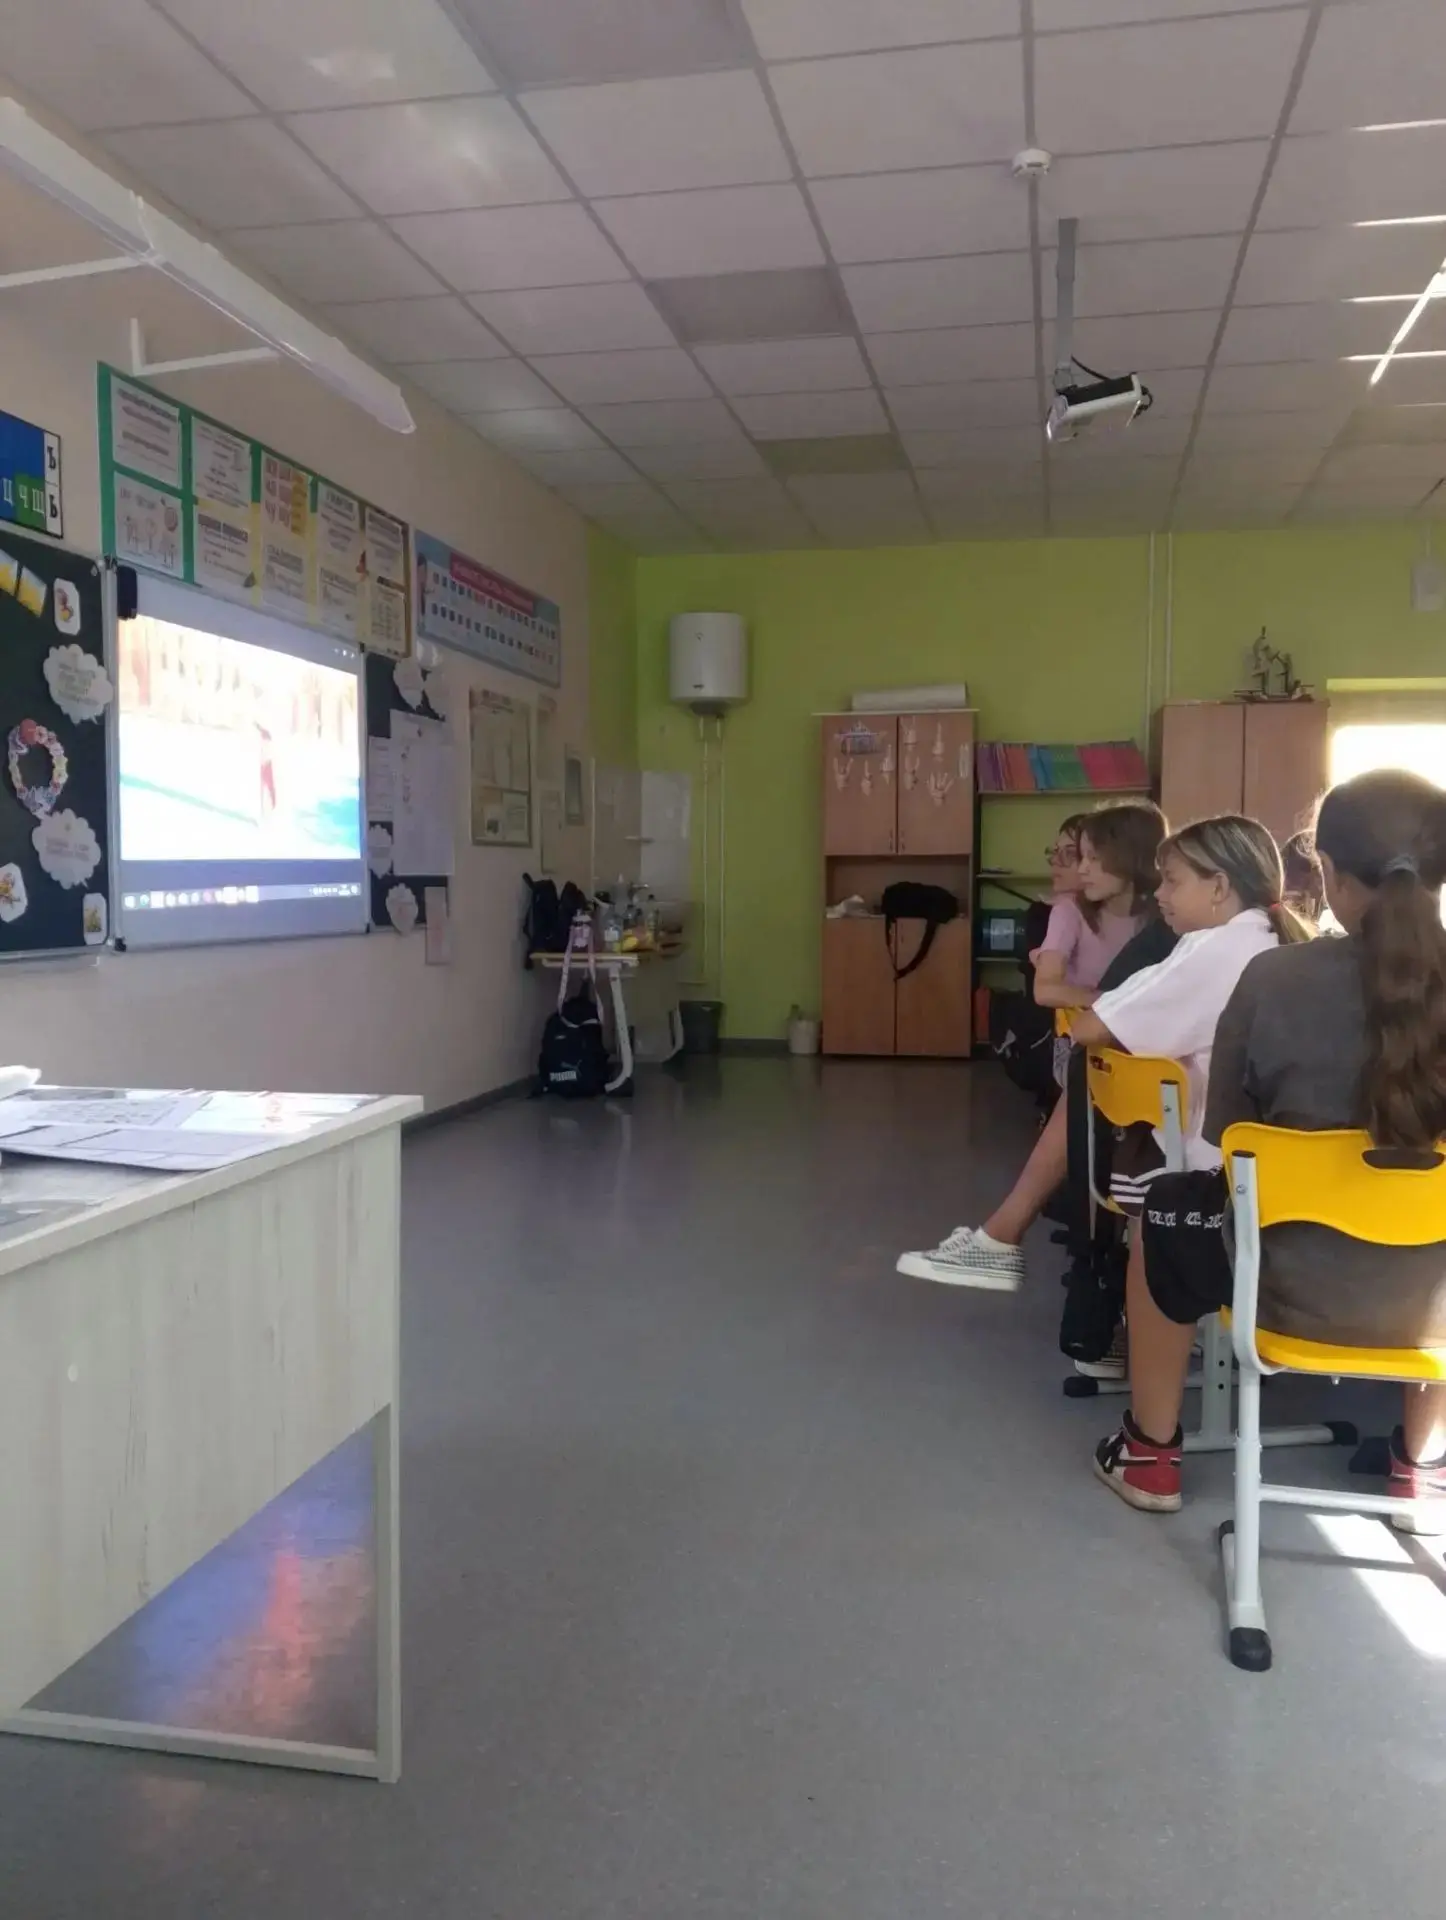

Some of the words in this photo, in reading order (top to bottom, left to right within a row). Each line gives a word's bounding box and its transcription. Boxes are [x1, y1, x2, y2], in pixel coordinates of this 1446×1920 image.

[47, 446, 56, 469] Ъ
[3, 478, 14, 507] Ц
[19, 484, 28, 508] Ч
[49, 494, 57, 518] Ь
